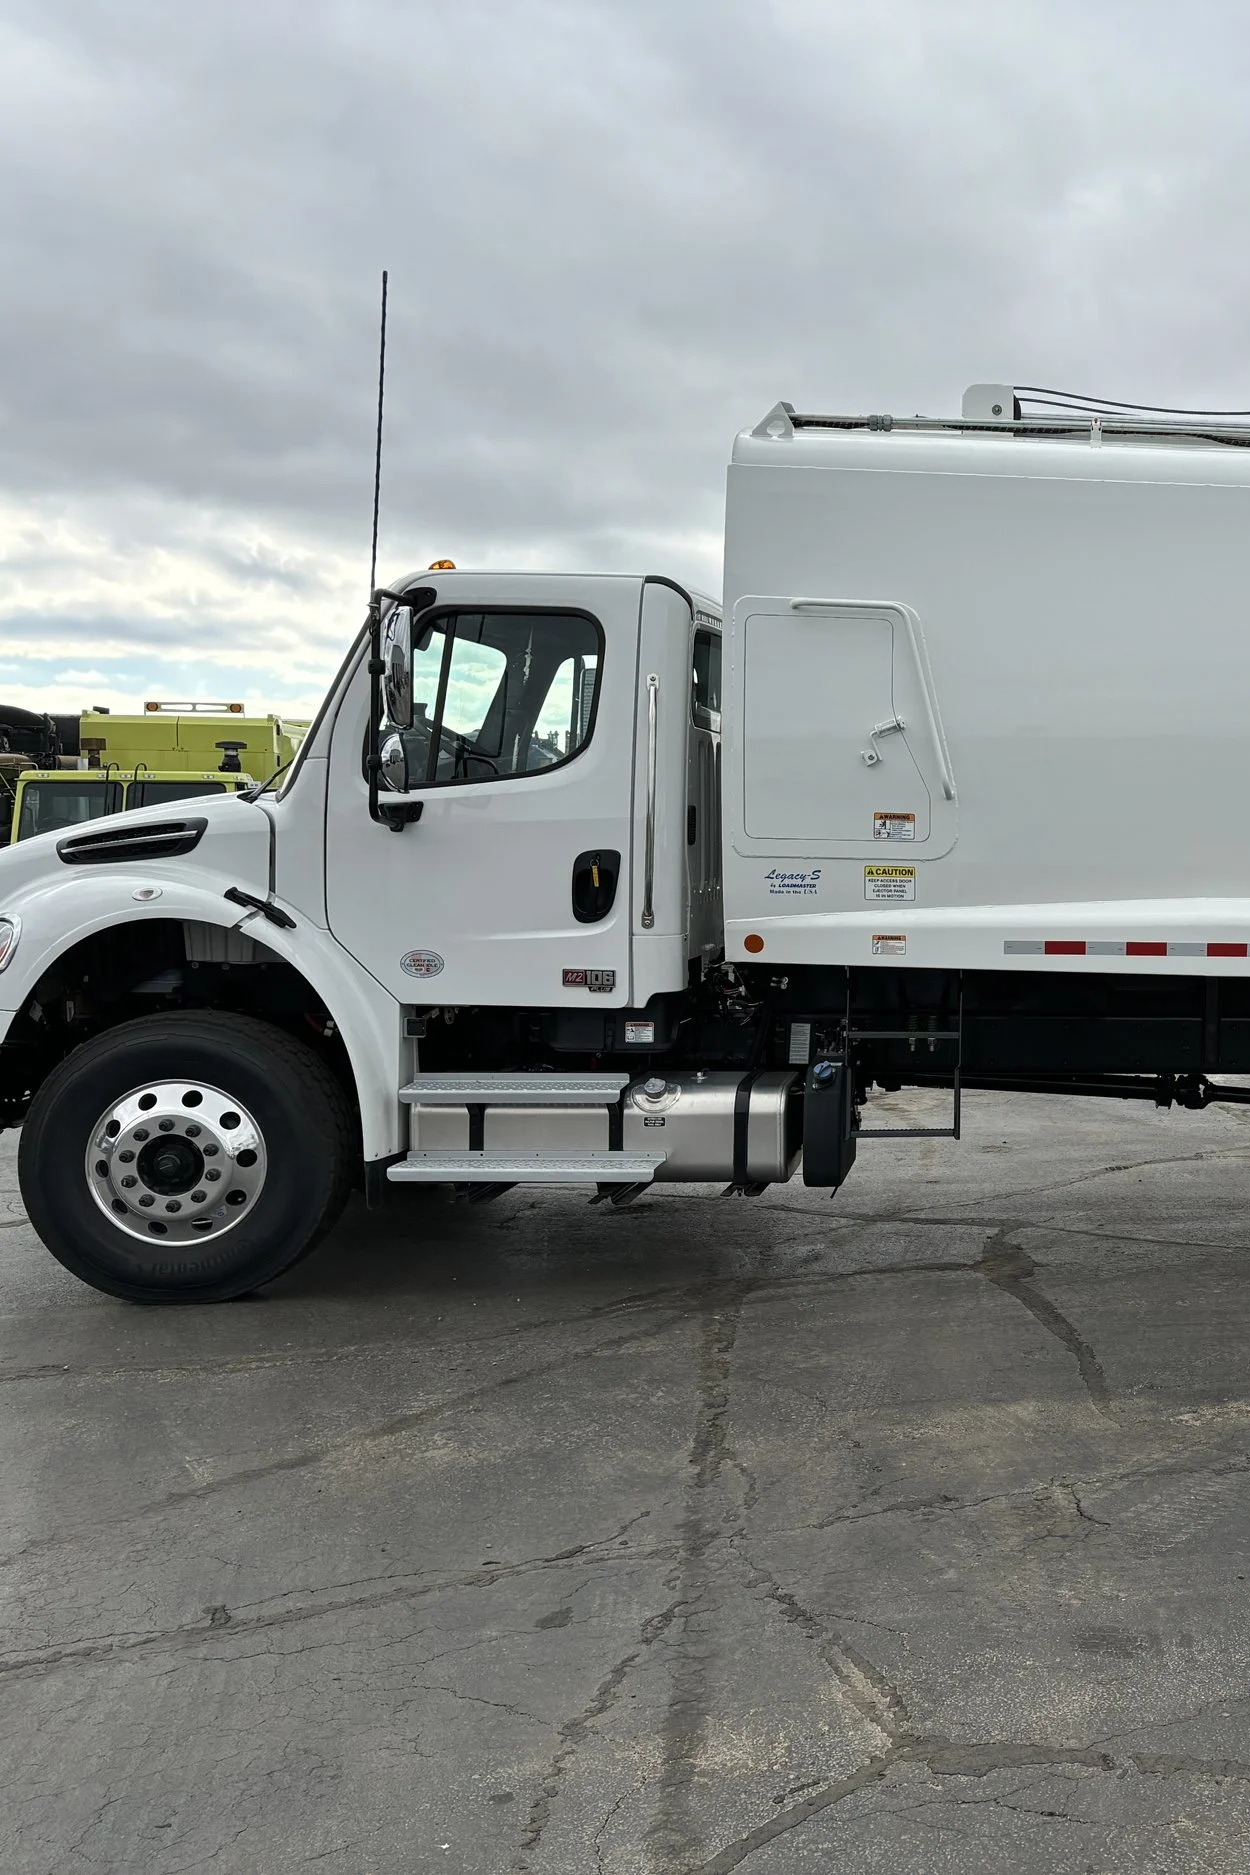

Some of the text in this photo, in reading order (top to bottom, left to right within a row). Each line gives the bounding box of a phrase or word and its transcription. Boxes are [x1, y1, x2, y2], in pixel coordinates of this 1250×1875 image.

[764, 869, 821, 882] Legacy-S
[875, 868, 913, 876] CAUTION
[565, 970, 614, 985] M2 106
